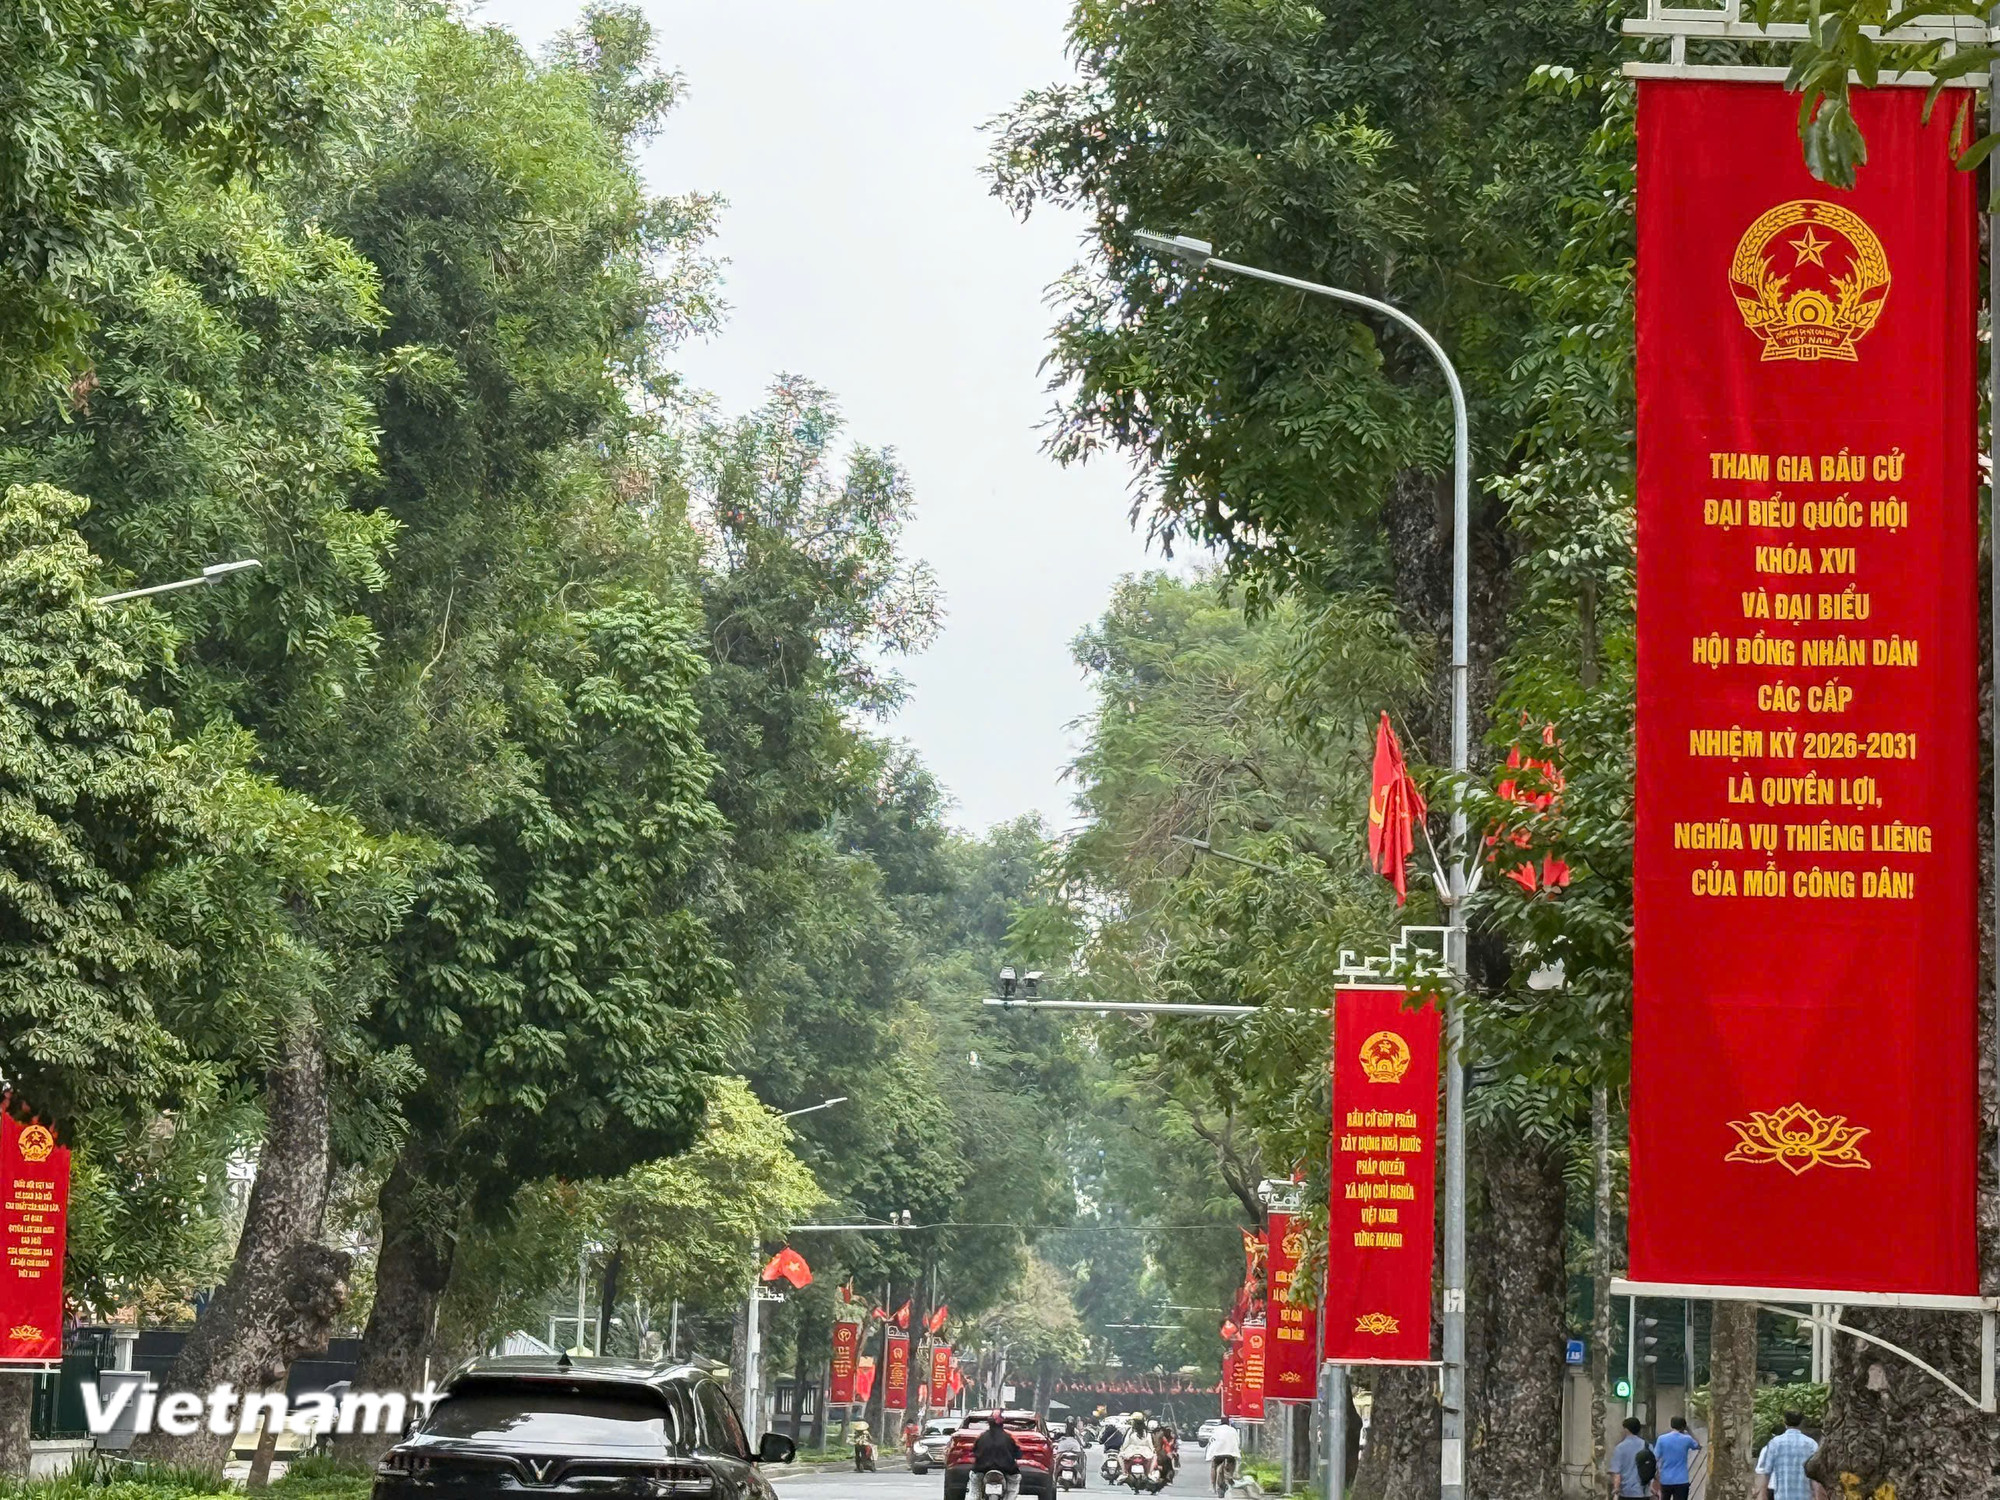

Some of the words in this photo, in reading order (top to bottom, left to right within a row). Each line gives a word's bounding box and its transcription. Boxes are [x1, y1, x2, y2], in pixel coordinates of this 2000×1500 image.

[1709, 452, 1770, 482] THAM
[1776, 455, 1814, 482] GIA
[1820, 446, 1866, 482] BẦU
[1872, 446, 1906, 482] CỬ
[1703, 498, 1742, 532] ĐẠI
[1748, 491, 1796, 528] BIỂU
[1802, 492, 1864, 531] QUỐC
[1870, 495, 1908, 534] HỘI
[1755, 542, 1813, 574] KHÓA
[1819, 547, 1856, 574] XVI
[1741, 586, 1771, 619] VÀ
[1774, 593, 1812, 626] ĐẠI
[1818, 582, 1870, 620] BIỂU
[1692, 631, 1730, 670] HỘI
[1735, 629, 1796, 667] ĐỒNG
[1801, 634, 1866, 667] NHÂN
[1872, 633, 1918, 667] DÂN
[1757, 679, 1801, 713] CÁC
[1807, 676, 1853, 713] CẤP
[1689, 724, 1764, 762] NHIỆM
[1769, 726, 1798, 759] KỲ
[1802, 732, 1916, 760] 2026-2031
[1728, 771, 1756, 804] LÀ
[1761, 769, 1834, 807] QUYỀN
[1840, 775, 1883, 811] LỢI,
[1674, 817, 1744, 850] NGHĨA
[1748, 823, 1778, 857] VỤ
[1783, 818, 1865, 852] THIÊNG
[1870, 819, 1932, 853] LIÊNG
[1691, 860, 1738, 897] CỦA
[1743, 860, 1786, 898] MỖI
[1792, 865, 1856, 899] CÔNG
[1862, 865, 1915, 900] DÂN!
